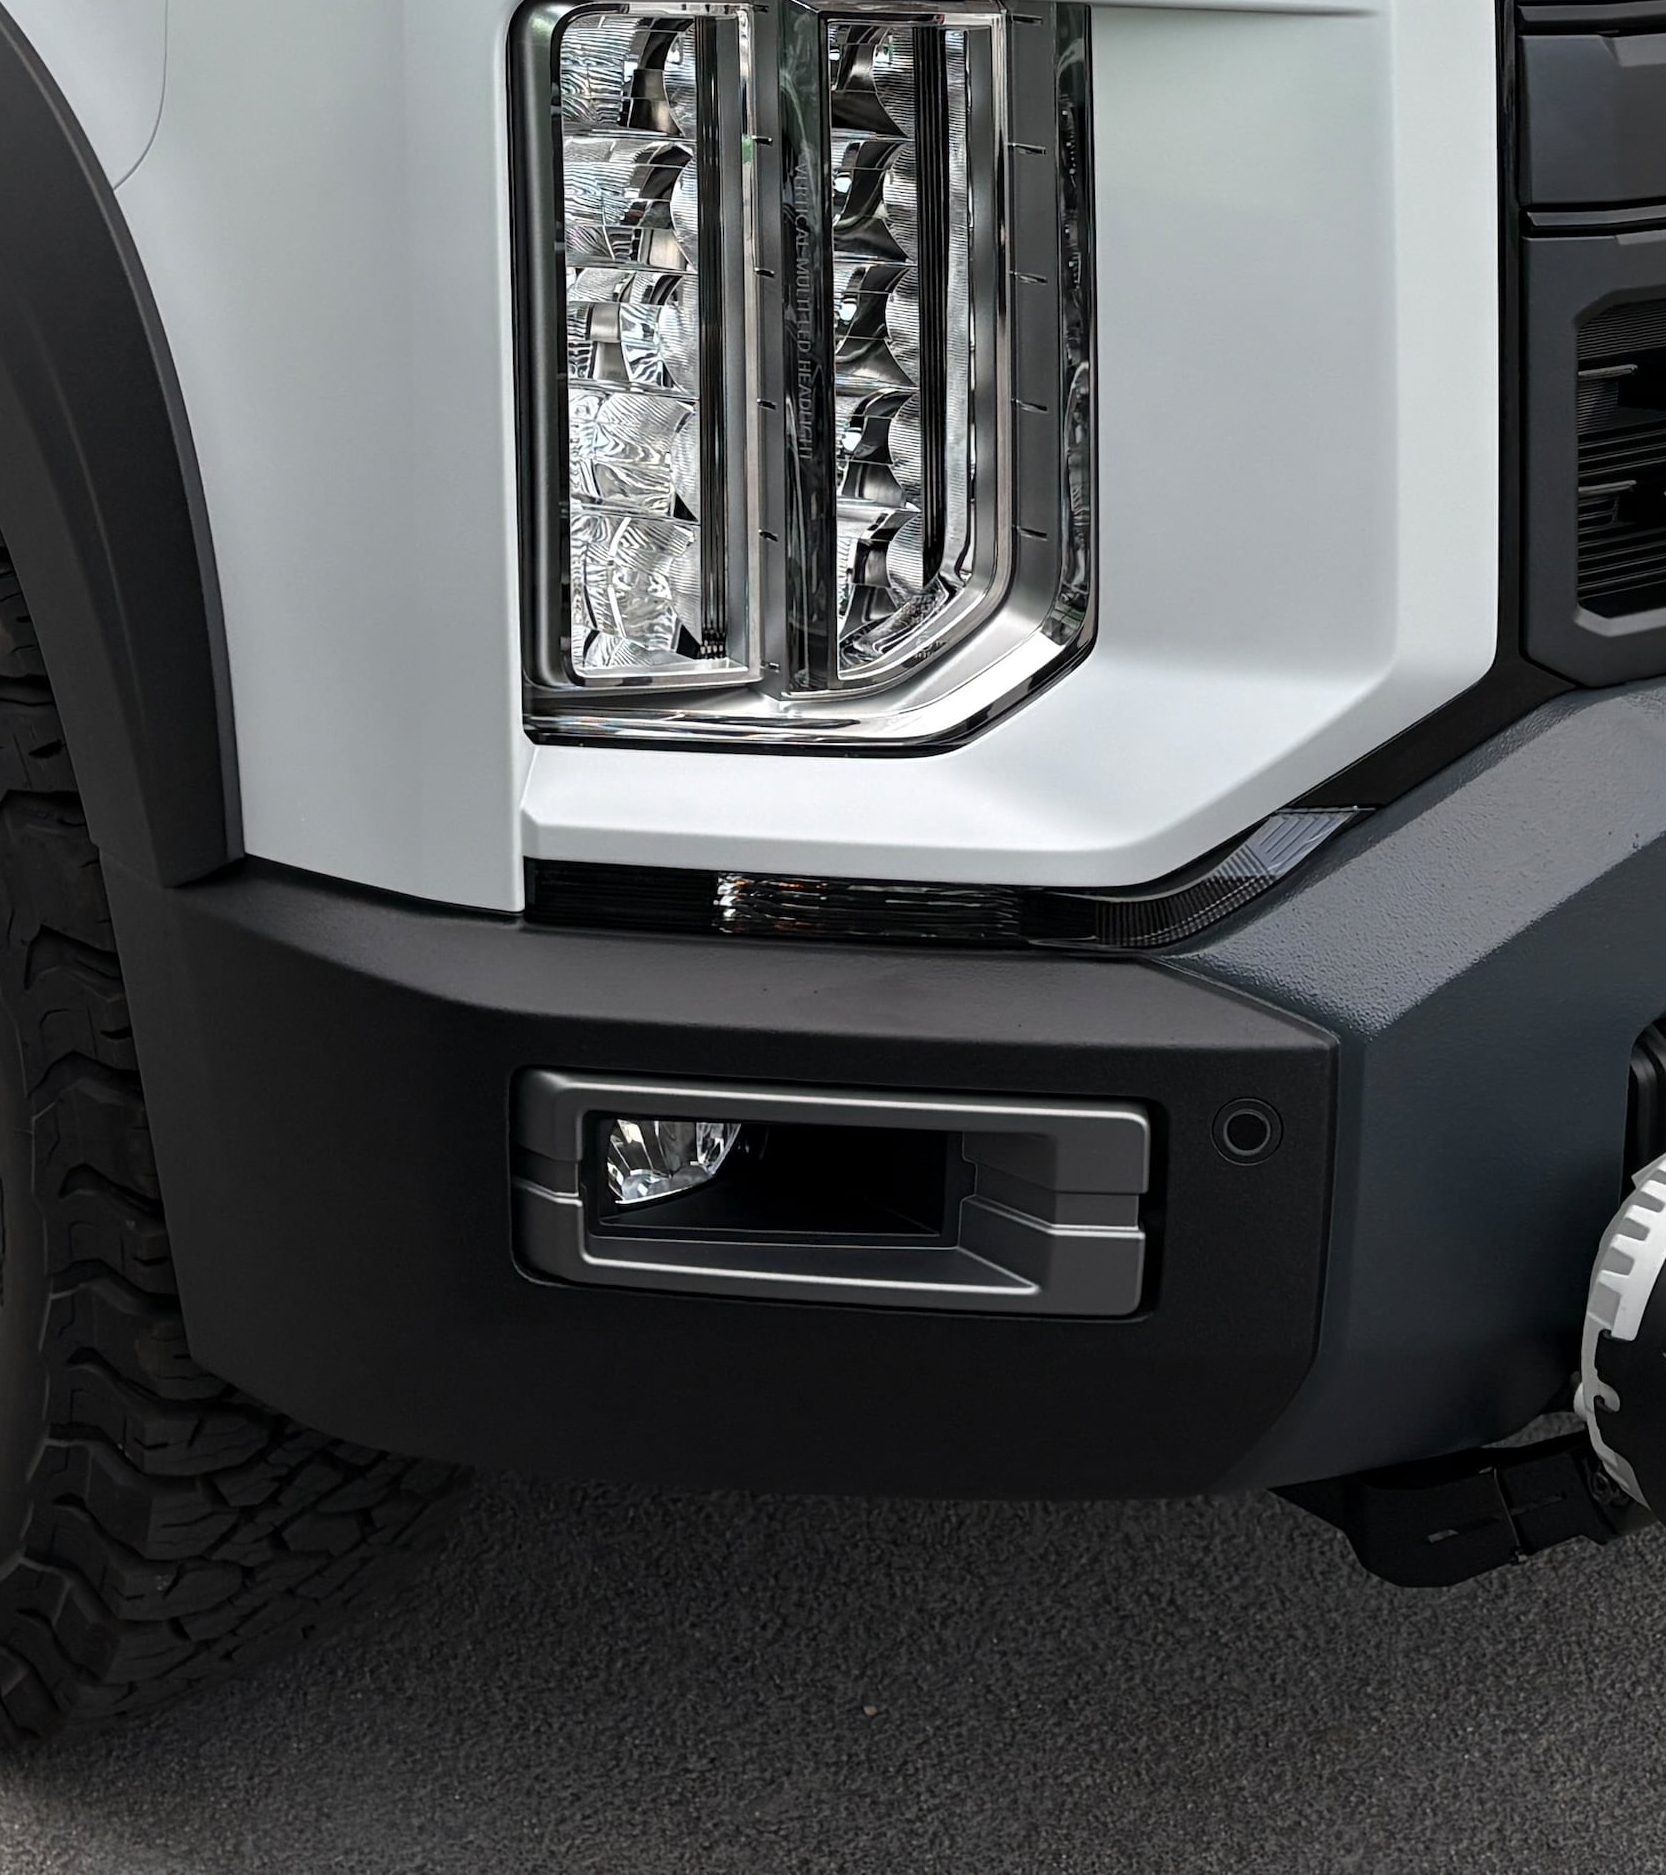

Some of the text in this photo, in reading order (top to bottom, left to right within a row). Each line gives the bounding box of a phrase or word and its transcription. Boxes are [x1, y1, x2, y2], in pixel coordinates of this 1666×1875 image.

[796, 258, 811, 311] MULTI
[797, 320, 811, 353] LED
[798, 360, 813, 460] HEADLIGHT
